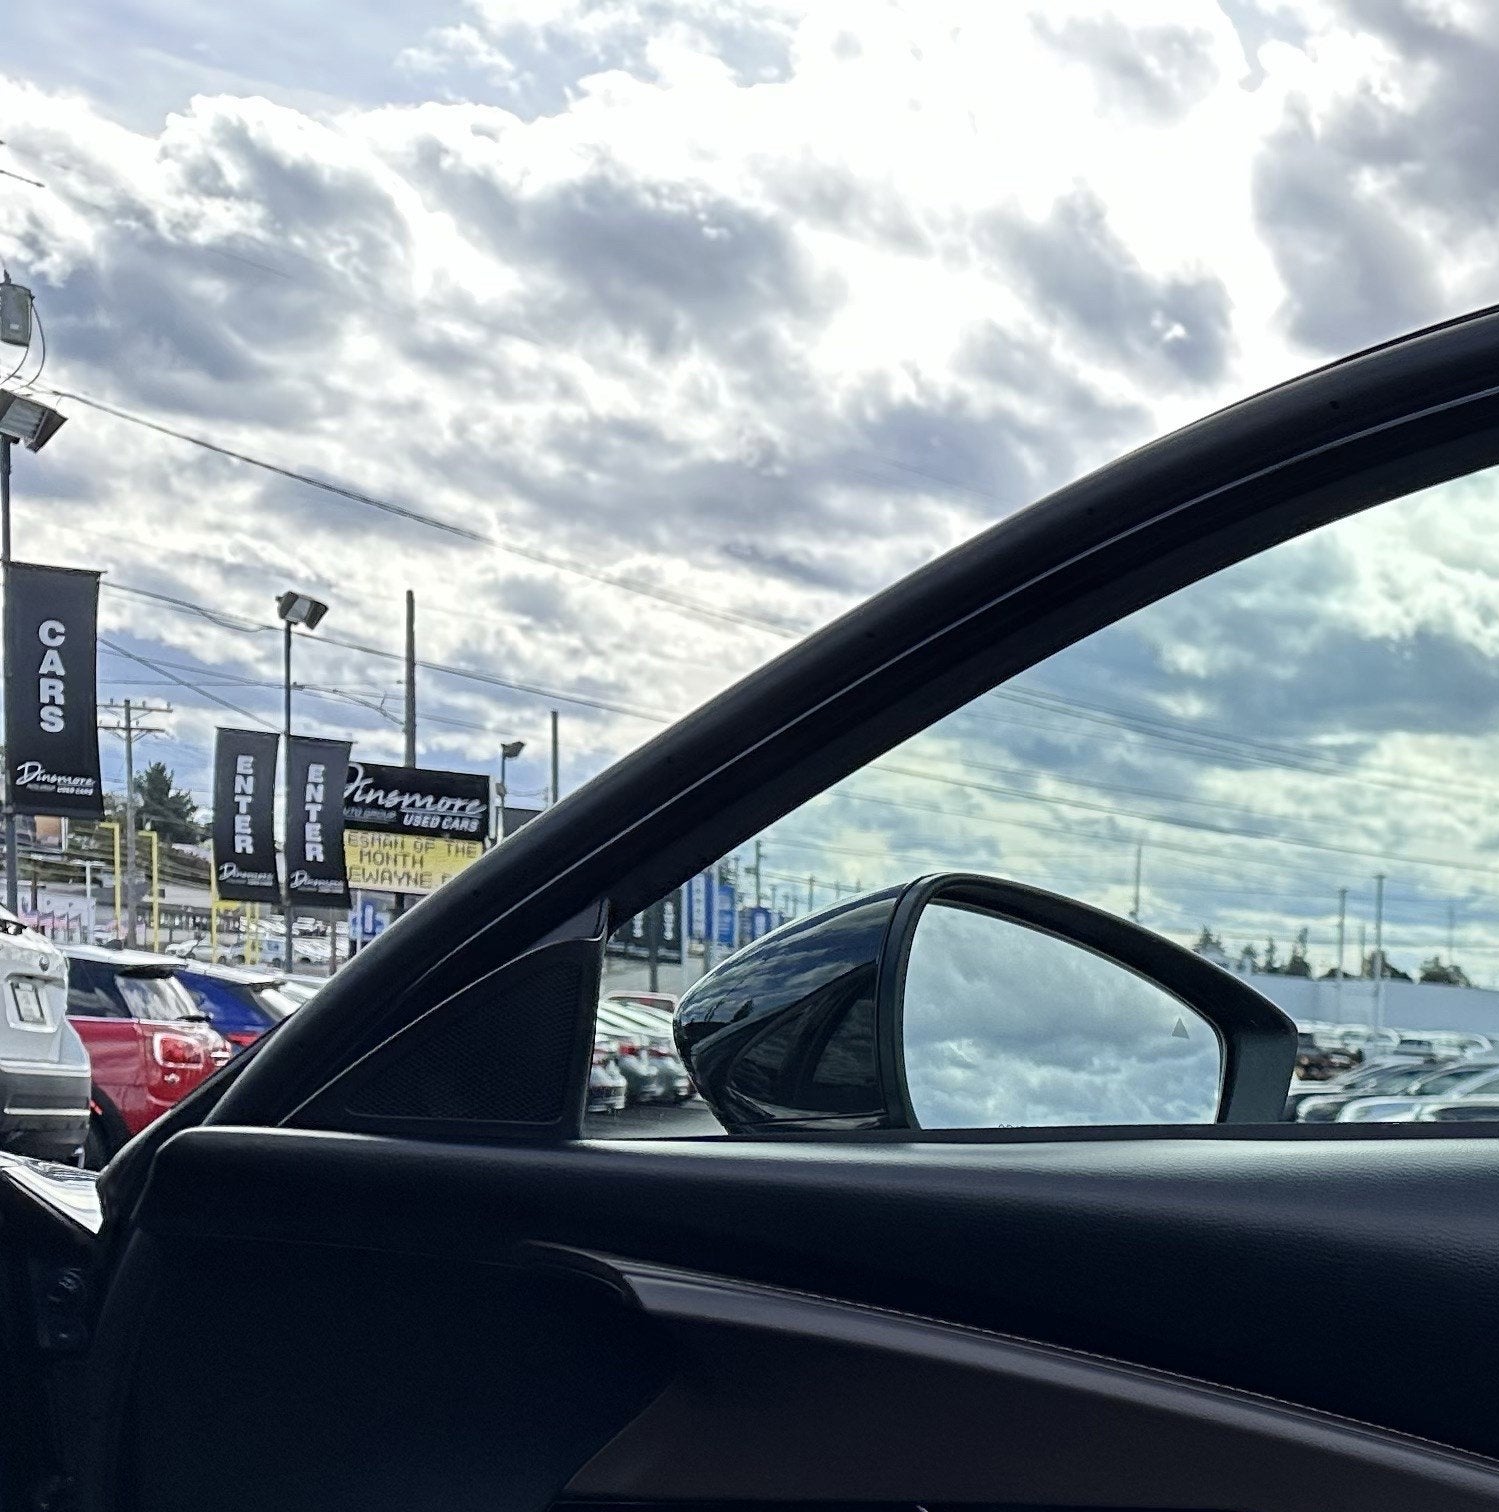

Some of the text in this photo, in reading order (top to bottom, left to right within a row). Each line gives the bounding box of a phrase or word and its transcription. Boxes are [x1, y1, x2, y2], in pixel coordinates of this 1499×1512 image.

[38, 619, 66, 733] CARS
[15, 761, 95, 786] Dinsmore
[233, 755, 254, 854] ENTER
[304, 763, 325, 862] ENTER
[403, 813, 440, 829] USED
[442, 815, 480, 833] CARS
[360, 849, 424, 869] MONTH
[414, 836, 435, 854] OF
[446, 840, 478, 859] THE
